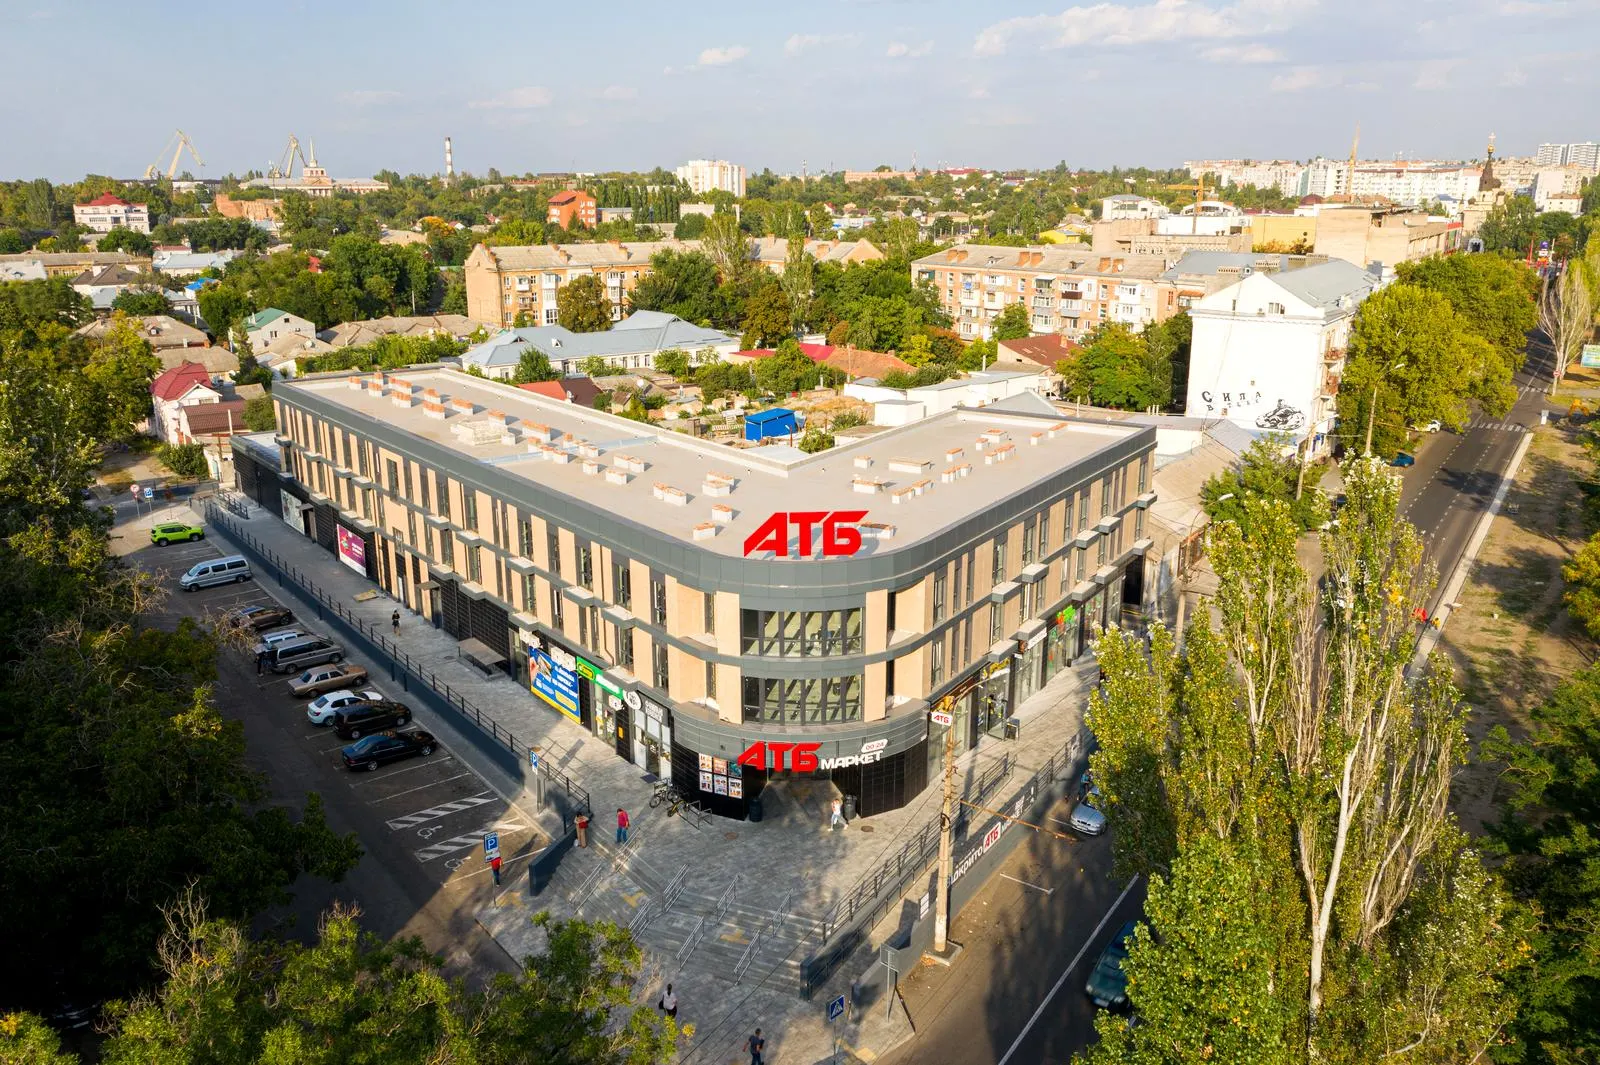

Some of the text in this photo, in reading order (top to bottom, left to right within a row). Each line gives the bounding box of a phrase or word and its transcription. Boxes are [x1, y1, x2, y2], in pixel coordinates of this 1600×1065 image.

[1201, 390, 1262, 403] СИЛА
[744, 510, 869, 558] АТБ
[933, 714, 950, 724] АТБ
[737, 741, 883, 773] АТБ МАРКЕТ
